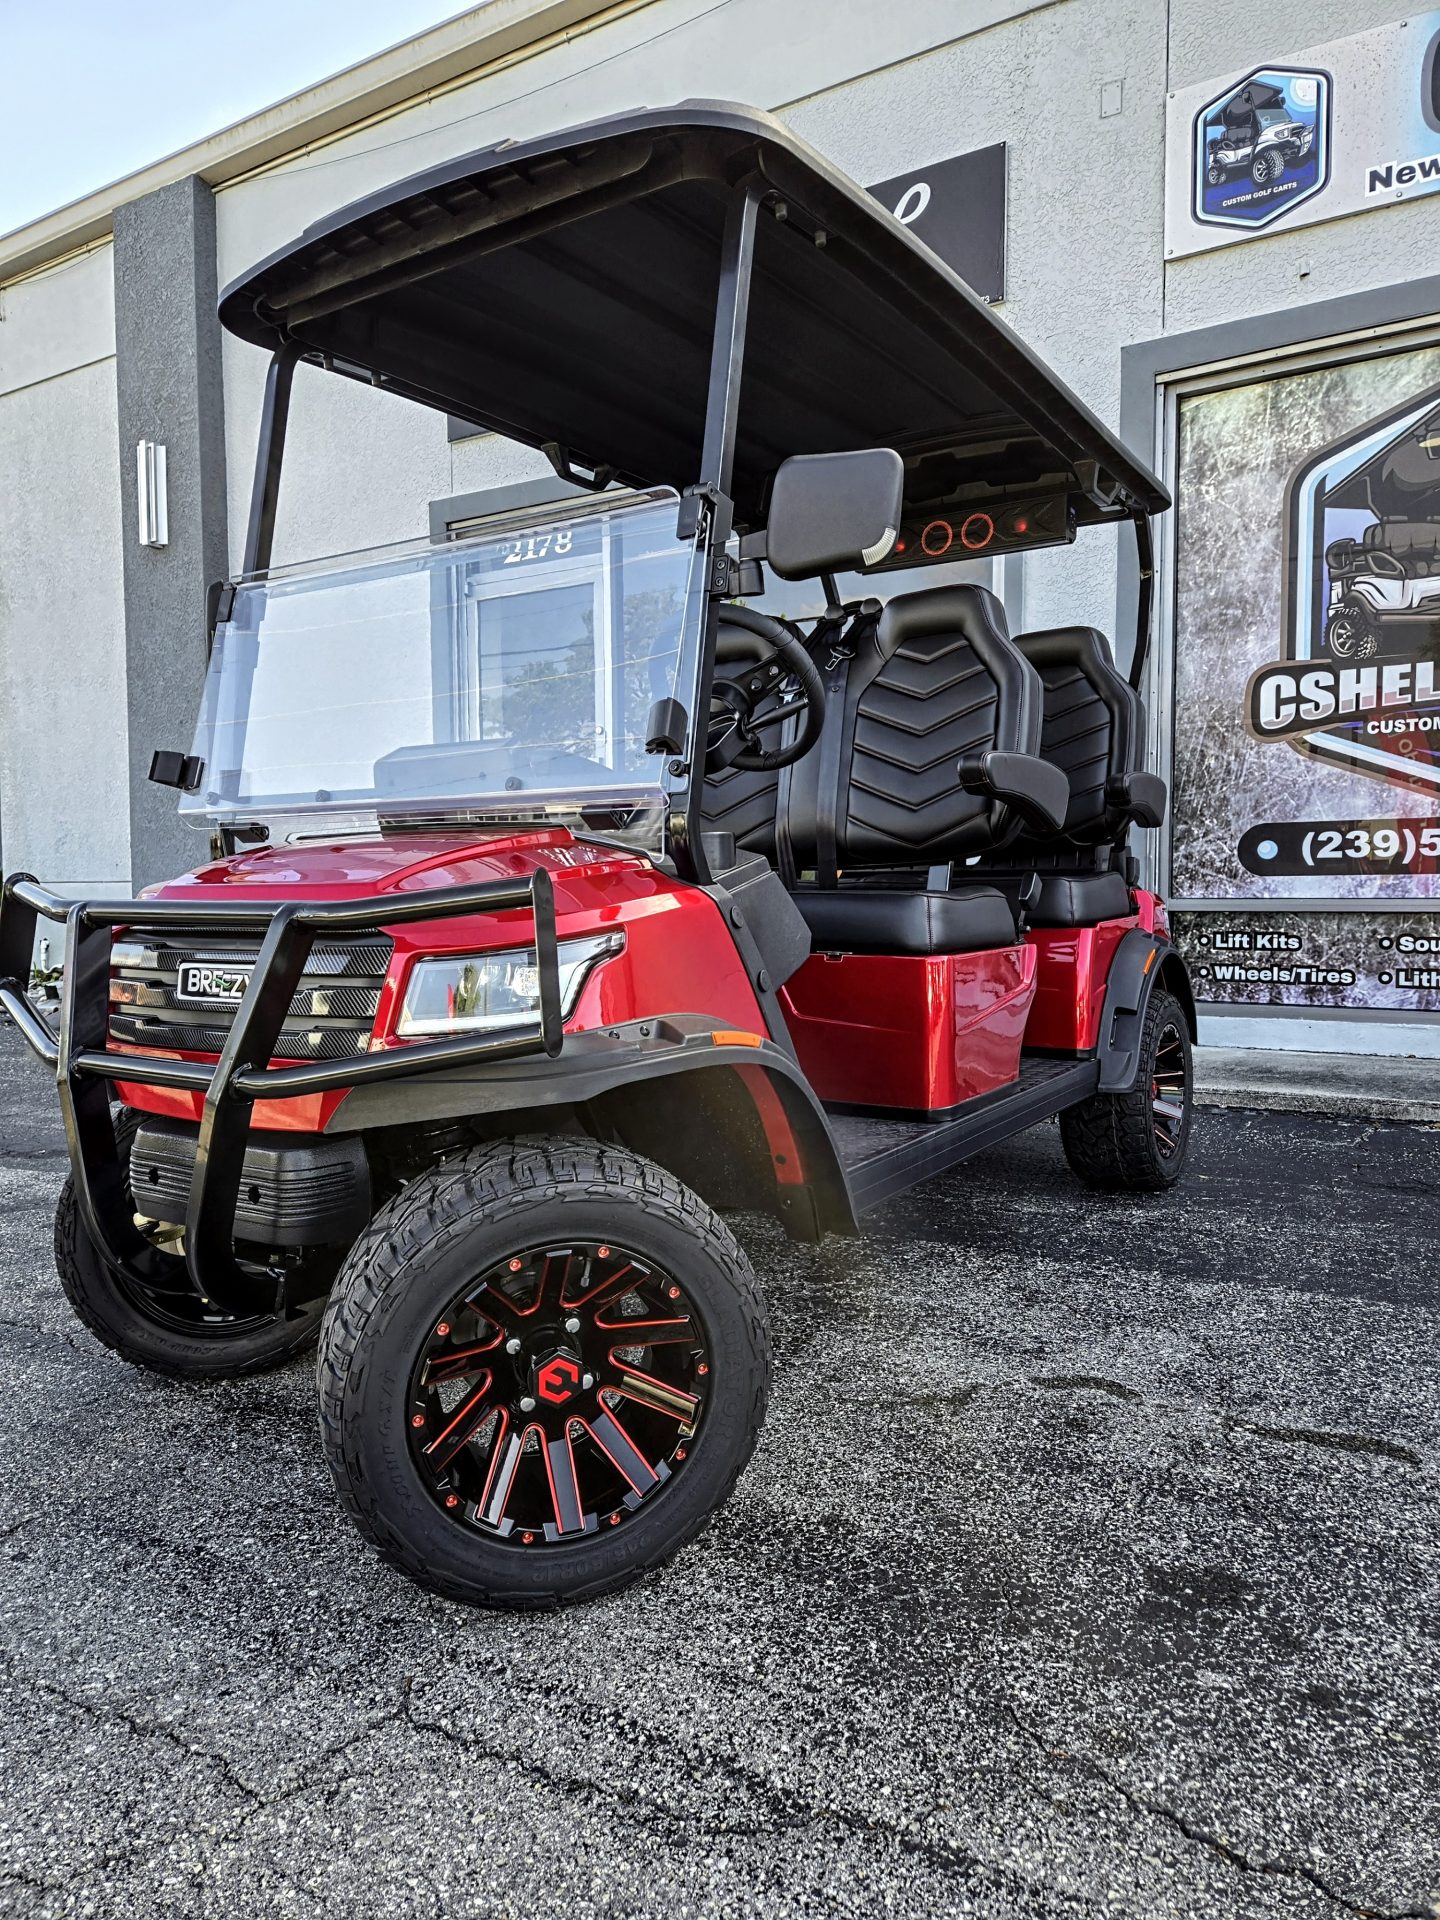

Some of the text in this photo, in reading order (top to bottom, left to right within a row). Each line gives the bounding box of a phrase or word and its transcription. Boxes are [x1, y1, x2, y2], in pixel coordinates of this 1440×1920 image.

[1222, 181, 1298, 207] CUSTOM GOLF CARTS
[503, 531, 573, 564] 2178
[1260, 661, 1440, 730] CSHEL
[1302, 828, 1440, 866] (239)5
[1215, 934, 1300, 949] Lift Kits
[1214, 966, 1353, 984] Wheels/Tires
